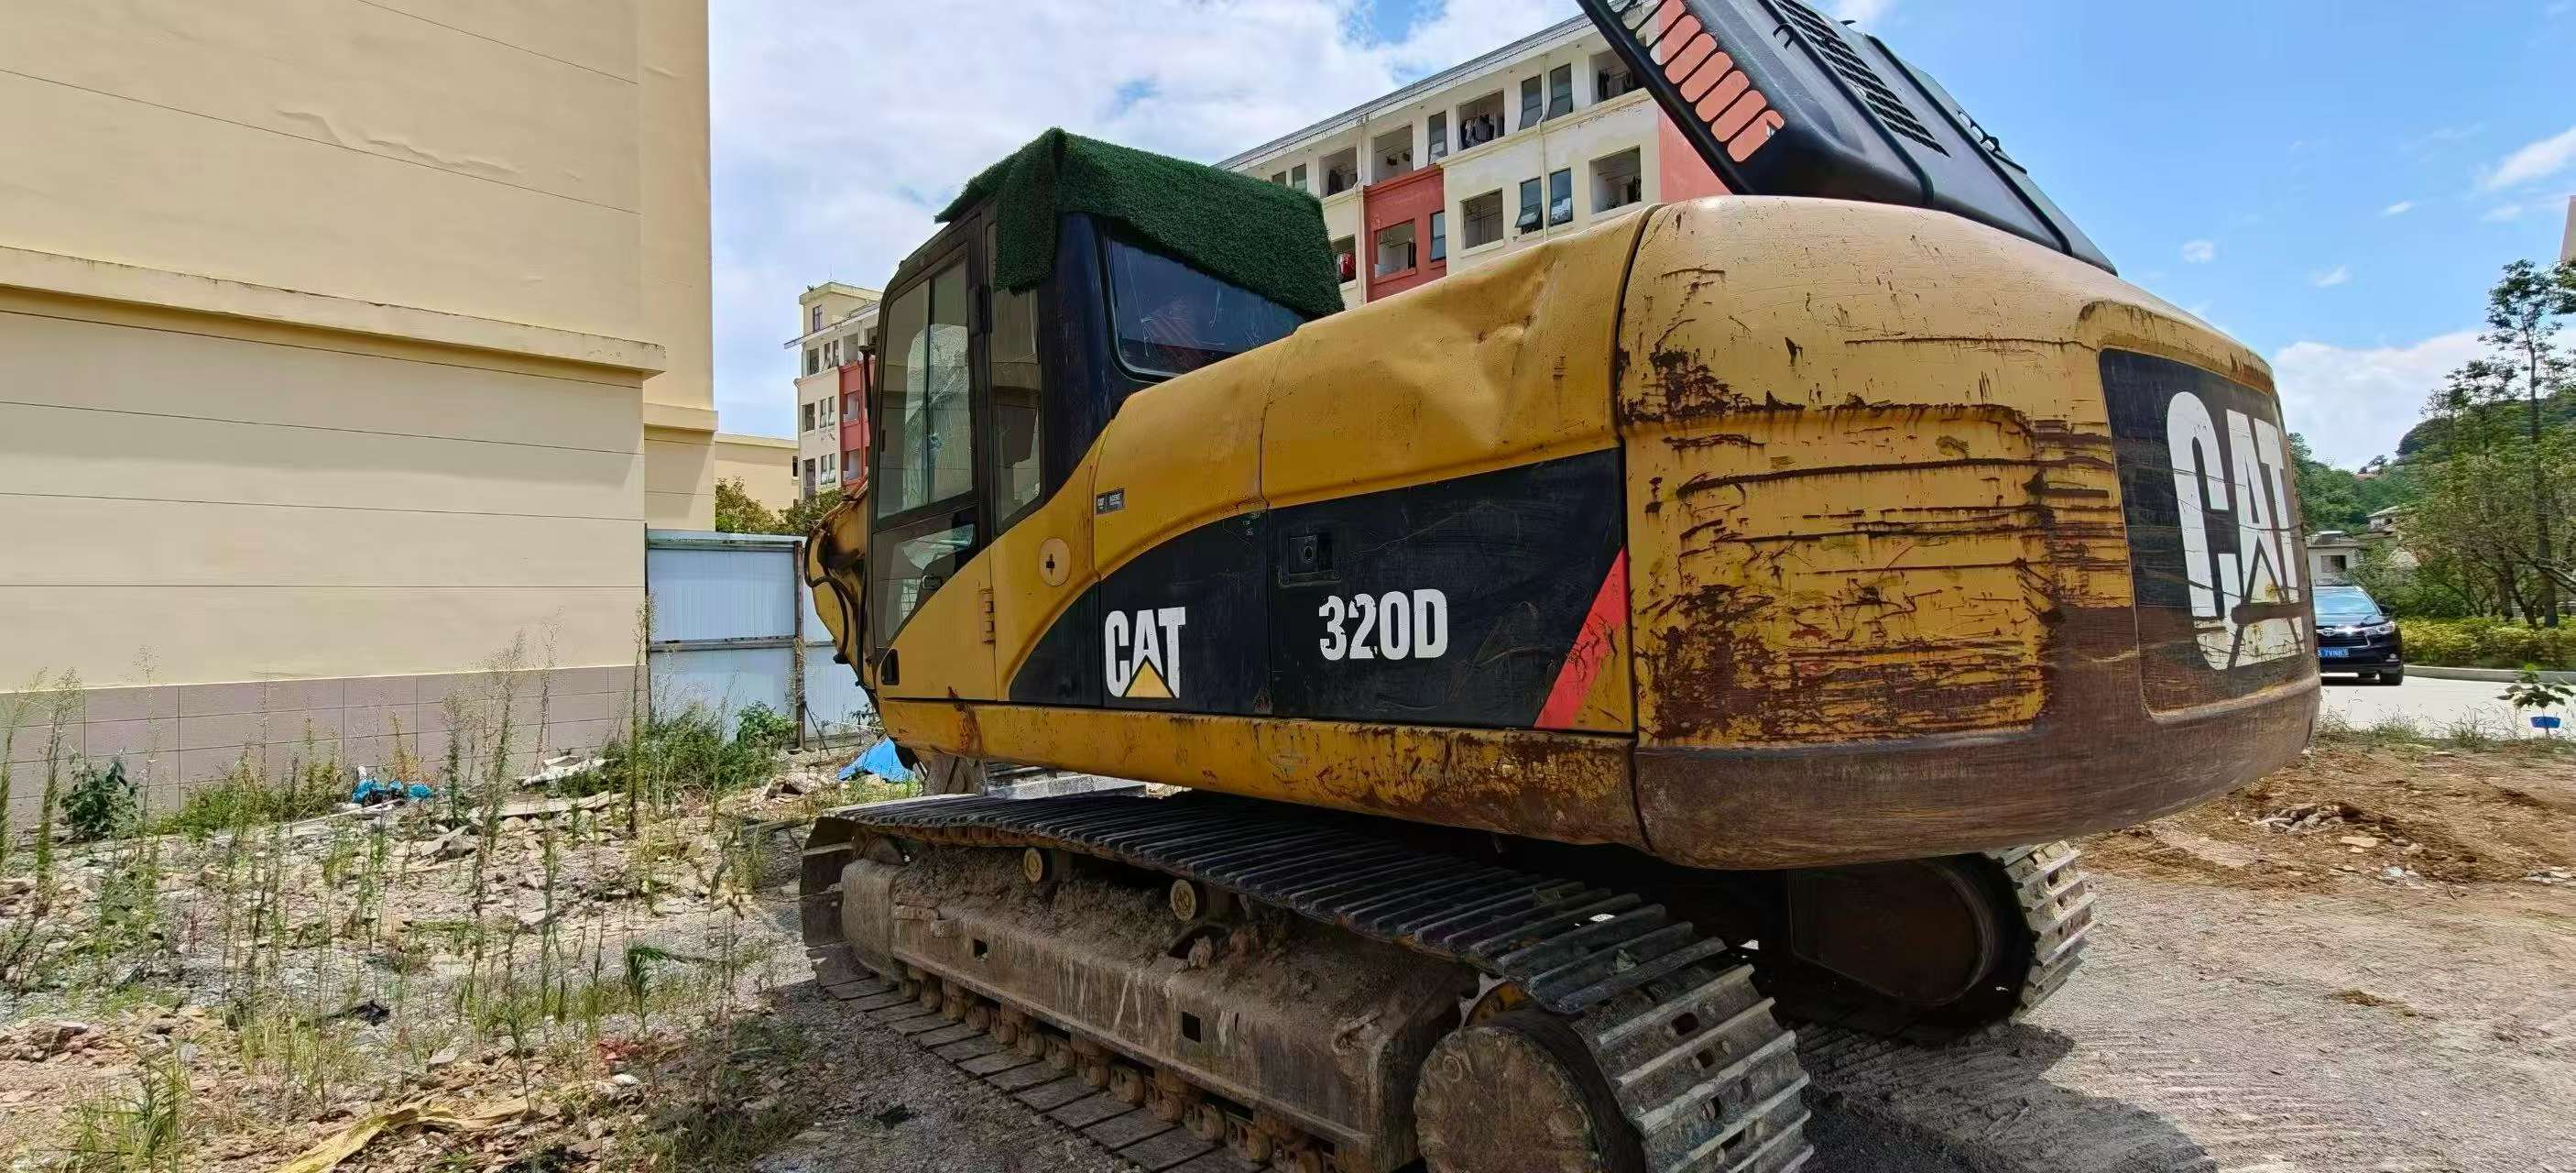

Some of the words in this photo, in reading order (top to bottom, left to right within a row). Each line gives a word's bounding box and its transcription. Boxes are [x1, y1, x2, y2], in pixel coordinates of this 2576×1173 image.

[2167, 391, 2305, 671] CAT
[1105, 607, 1186, 699] CAT
[1318, 588, 1448, 661] 320D
